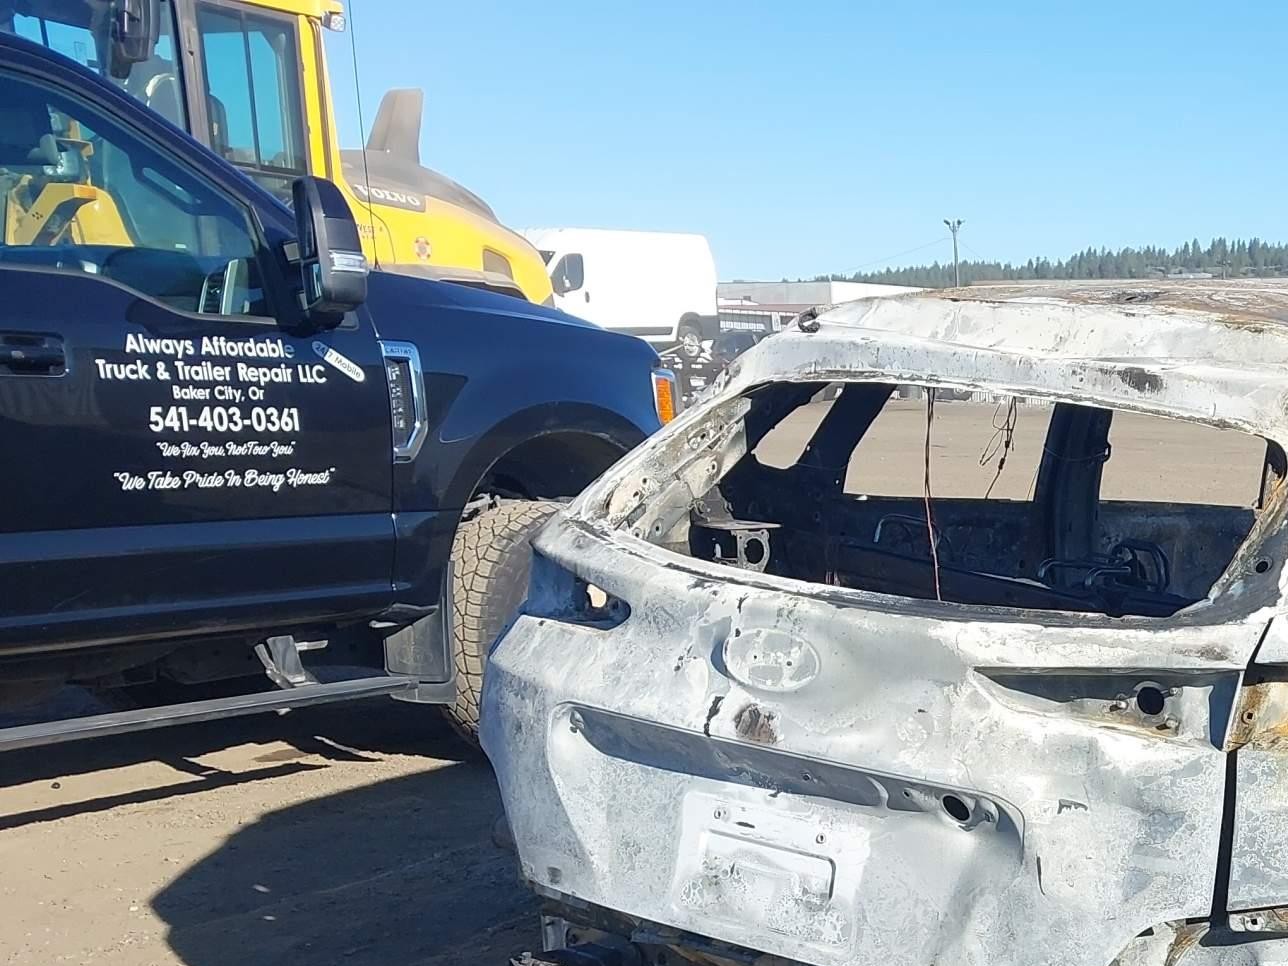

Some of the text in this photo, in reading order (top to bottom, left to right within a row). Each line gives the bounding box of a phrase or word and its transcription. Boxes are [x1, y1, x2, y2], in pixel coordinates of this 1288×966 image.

[354, 184, 420, 207] VOLVO
[124, 333, 296, 359] Always Affordable
[95, 359, 328, 385] Truck & Trailer Repair LLC
[335, 355, 362, 379] Mobile
[172, 386, 265, 403] Baker City, Or
[148, 406, 300, 433] 541-403-0361
[156, 441, 180, 457] "We
[179, 442, 200, 458] Fix
[225, 442, 248, 456] Not
[246, 441, 270, 456] Tow
[270, 441, 297, 458] You"
[113, 467, 336, 492] "We Take Pride In Being Honest"
